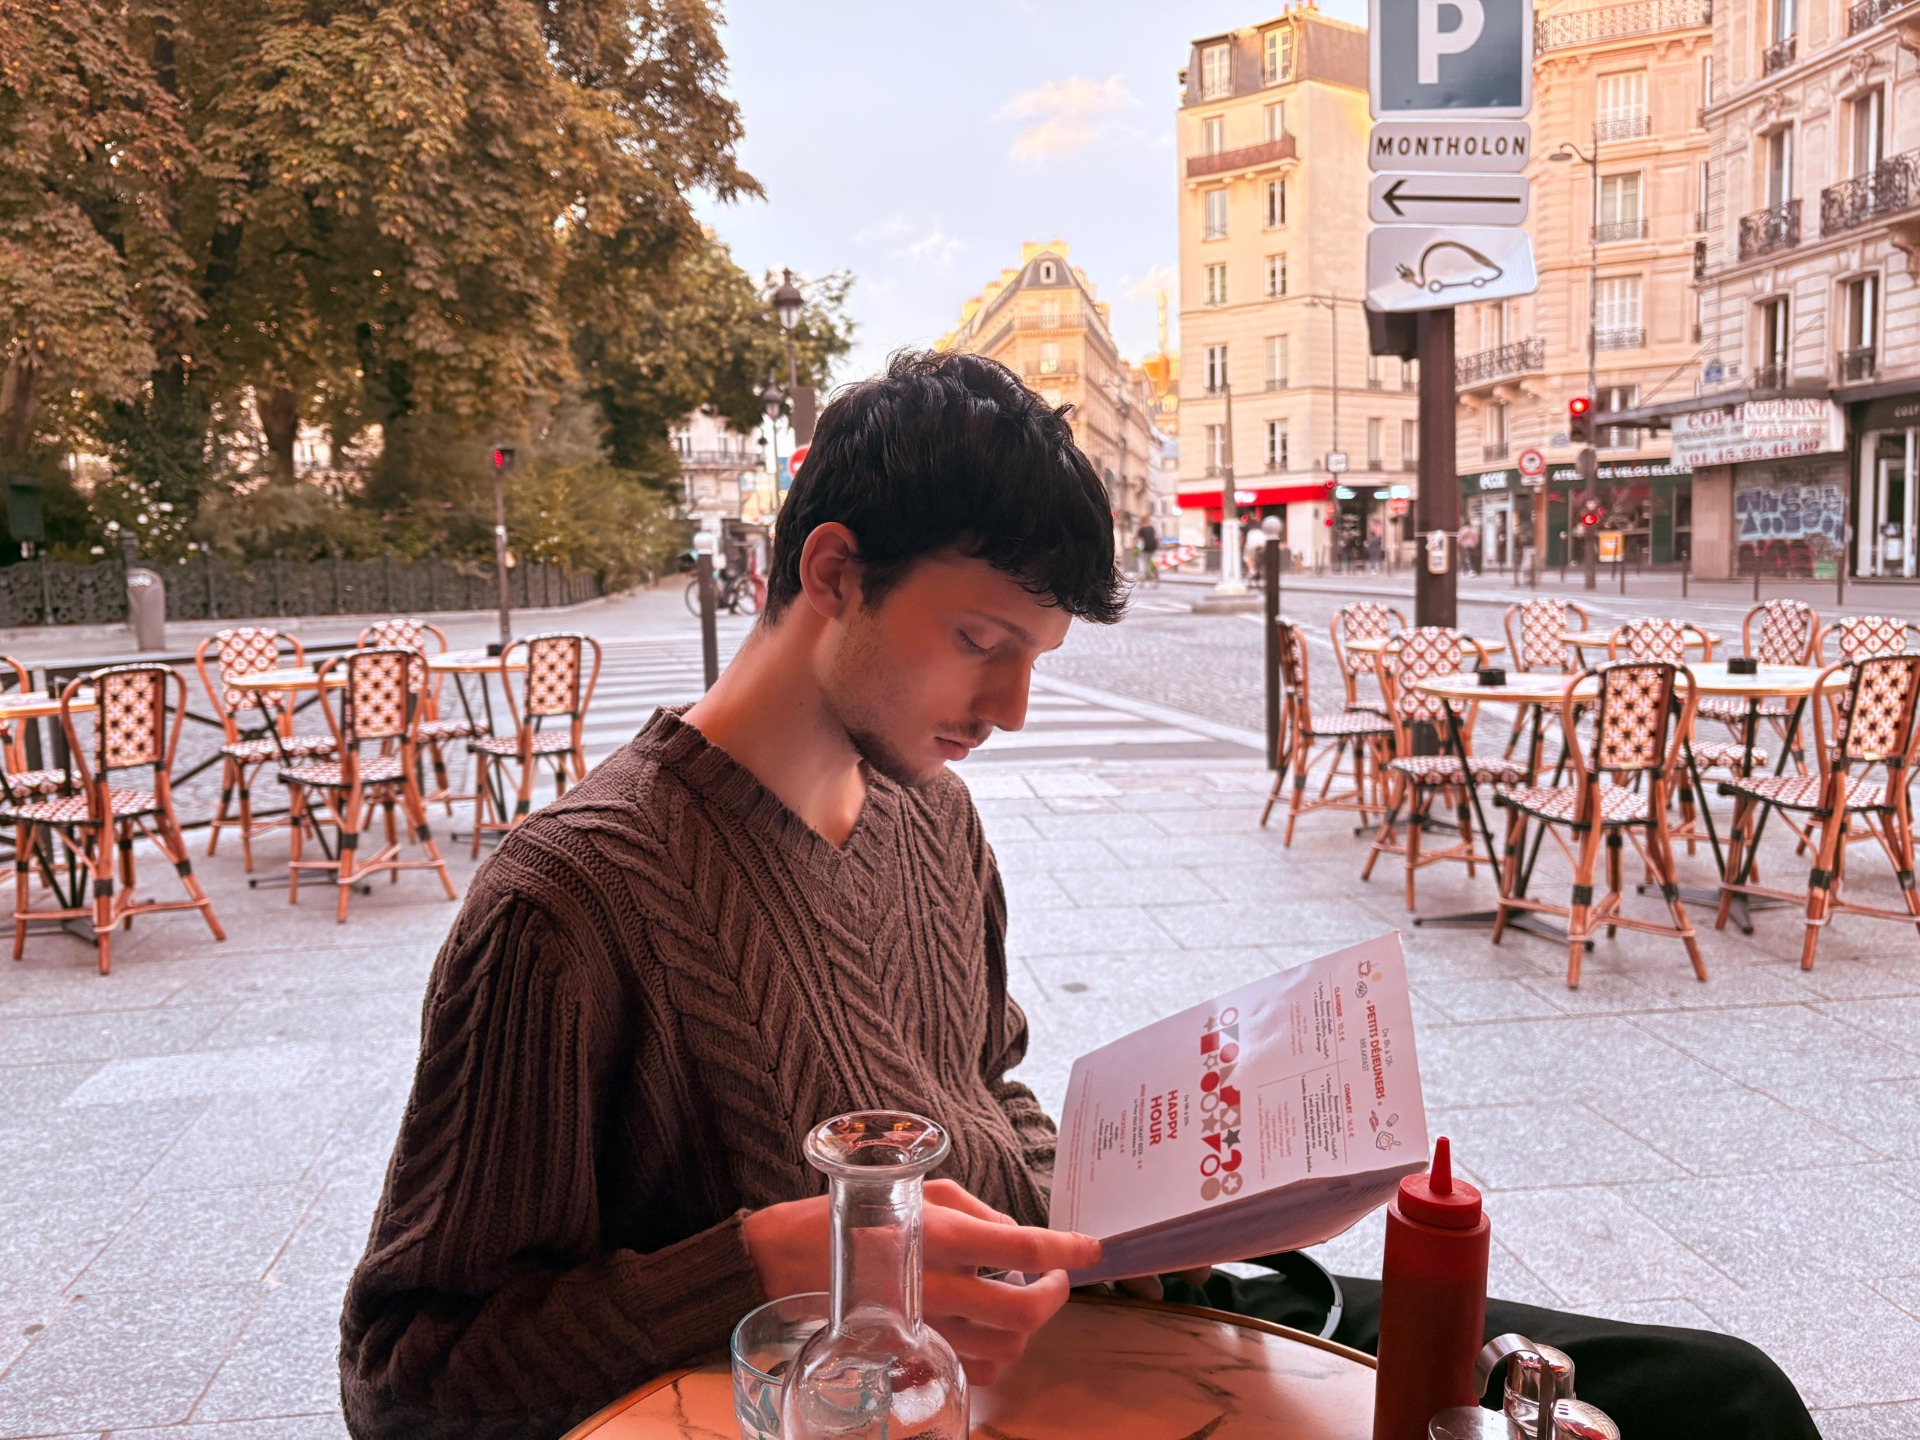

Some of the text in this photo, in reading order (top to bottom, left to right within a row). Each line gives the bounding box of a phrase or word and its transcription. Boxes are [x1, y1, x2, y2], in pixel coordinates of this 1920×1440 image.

[1418, 0, 1485, 83] P
[1376, 135, 1526, 157] MONTHOLON
[1747, 400, 1824, 417] COPIPRINT
[1597, 467, 1613, 479] DE
[1382, 1027, 1388, 1038] De
[1383, 1038, 1390, 1048] 8h
[1359, 1037, 1368, 1072] BREAKFAST
[1366, 1004, 1385, 1100] PETITS DÉJEUNERS
[1343, 1082, 1351, 1114] COMPLET
[1149, 1094, 1162, 1146] HOUR
[1166, 1089, 1177, 1141] HAPPY
